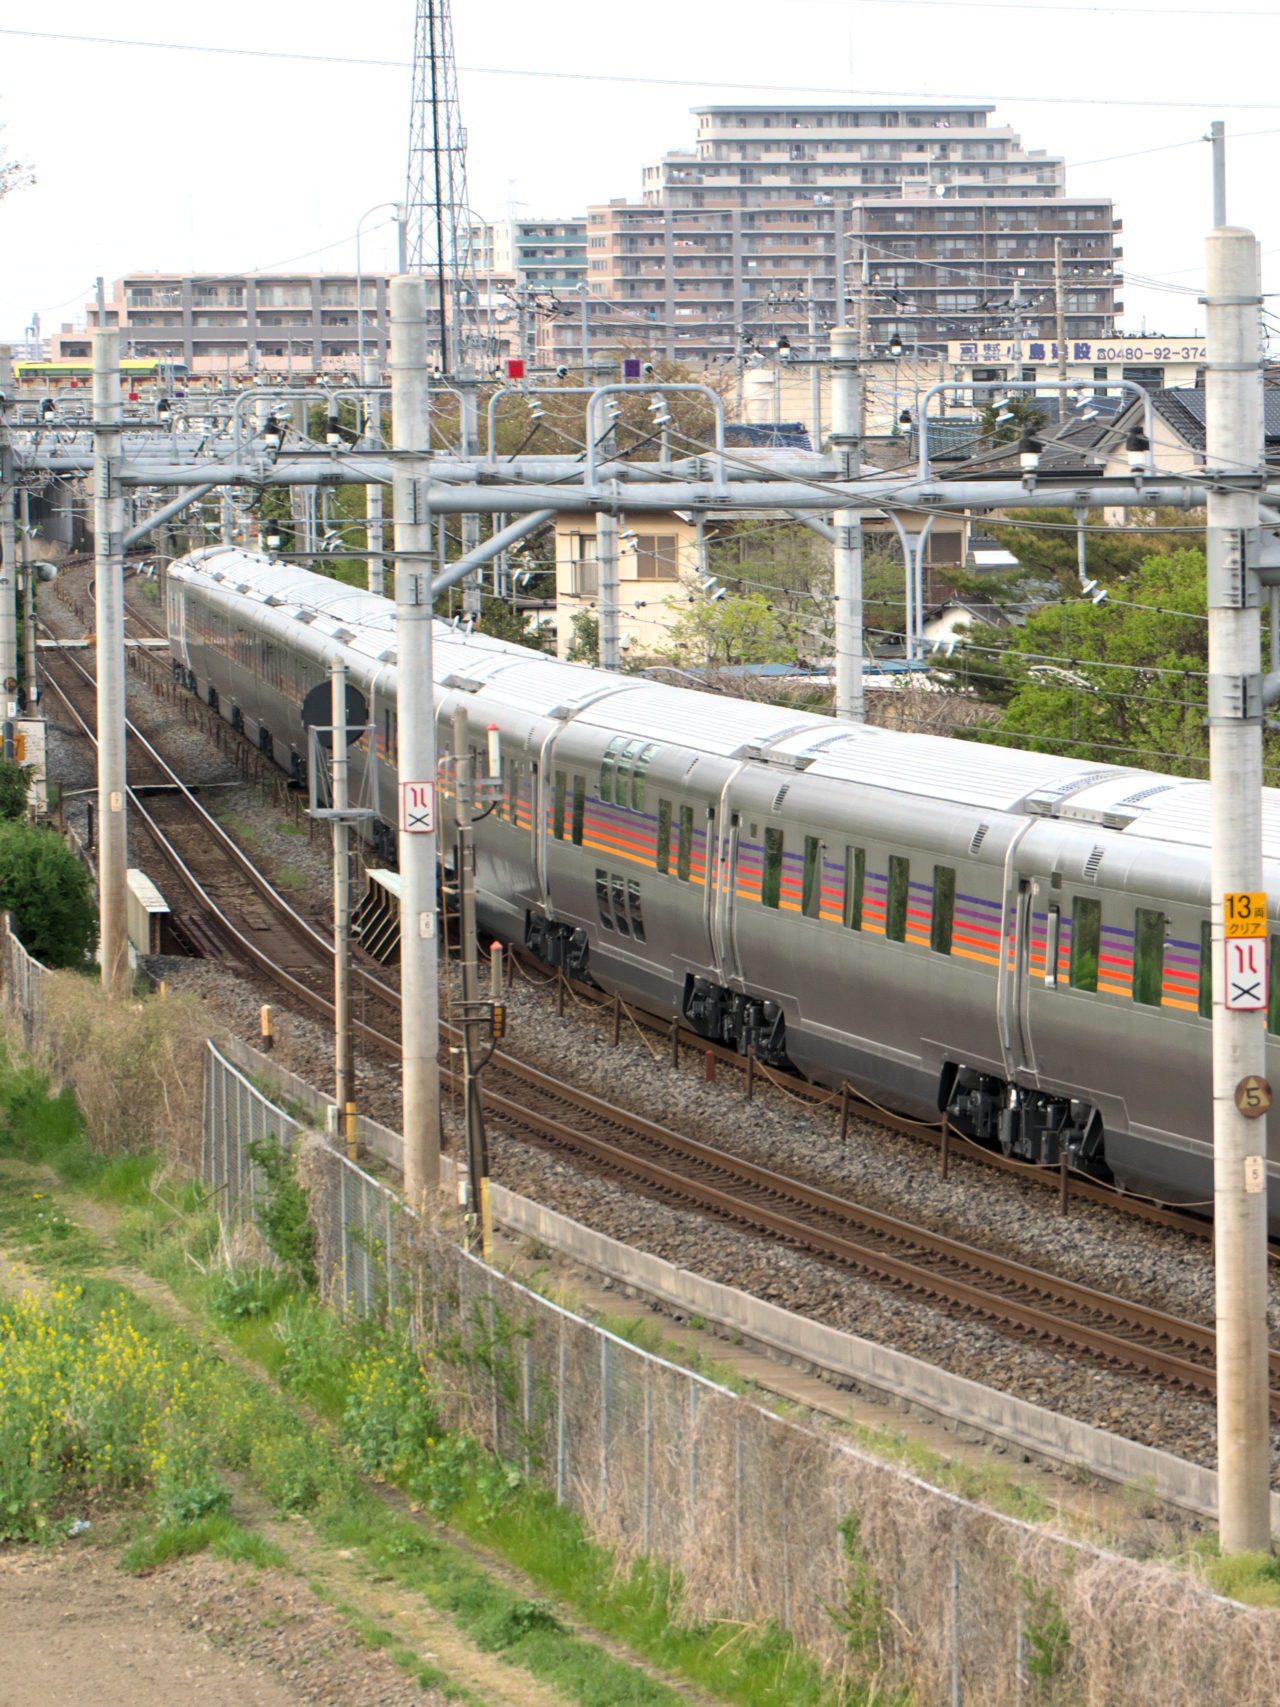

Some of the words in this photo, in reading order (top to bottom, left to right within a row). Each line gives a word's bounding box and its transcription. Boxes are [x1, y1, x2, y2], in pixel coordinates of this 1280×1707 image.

[1229, 923, 1261, 935] クリア
[1246, 1087, 1260, 1107] 5
